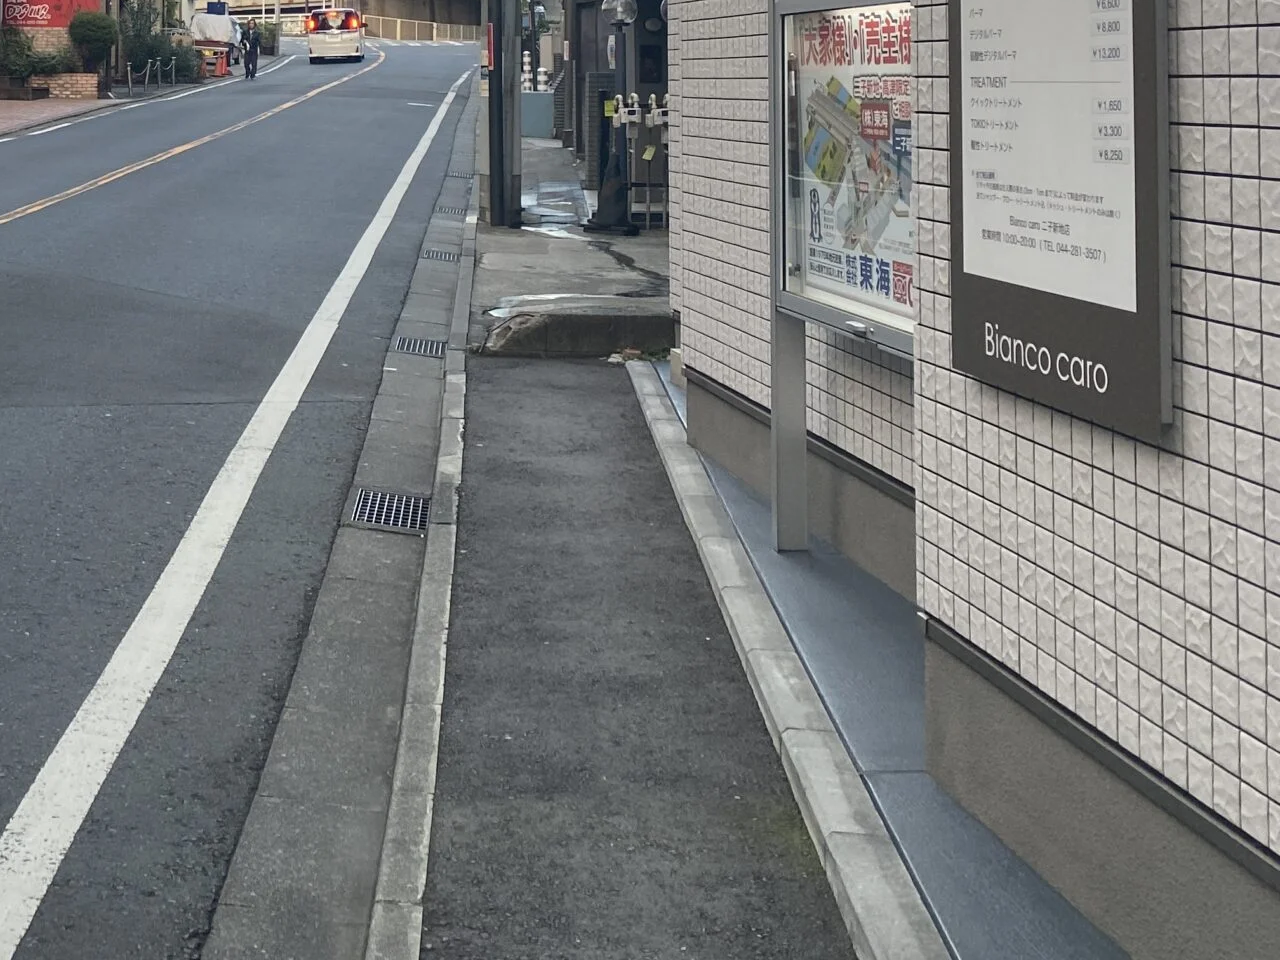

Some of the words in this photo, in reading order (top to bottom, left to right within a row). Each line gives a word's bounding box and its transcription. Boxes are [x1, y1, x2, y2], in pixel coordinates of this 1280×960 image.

[969, 76, 1008, 89] TREATMENT
[859, 254, 891, 297] 東海
[985, 322, 1052, 375] Bianco
[1056, 352, 1109, 394] caro
